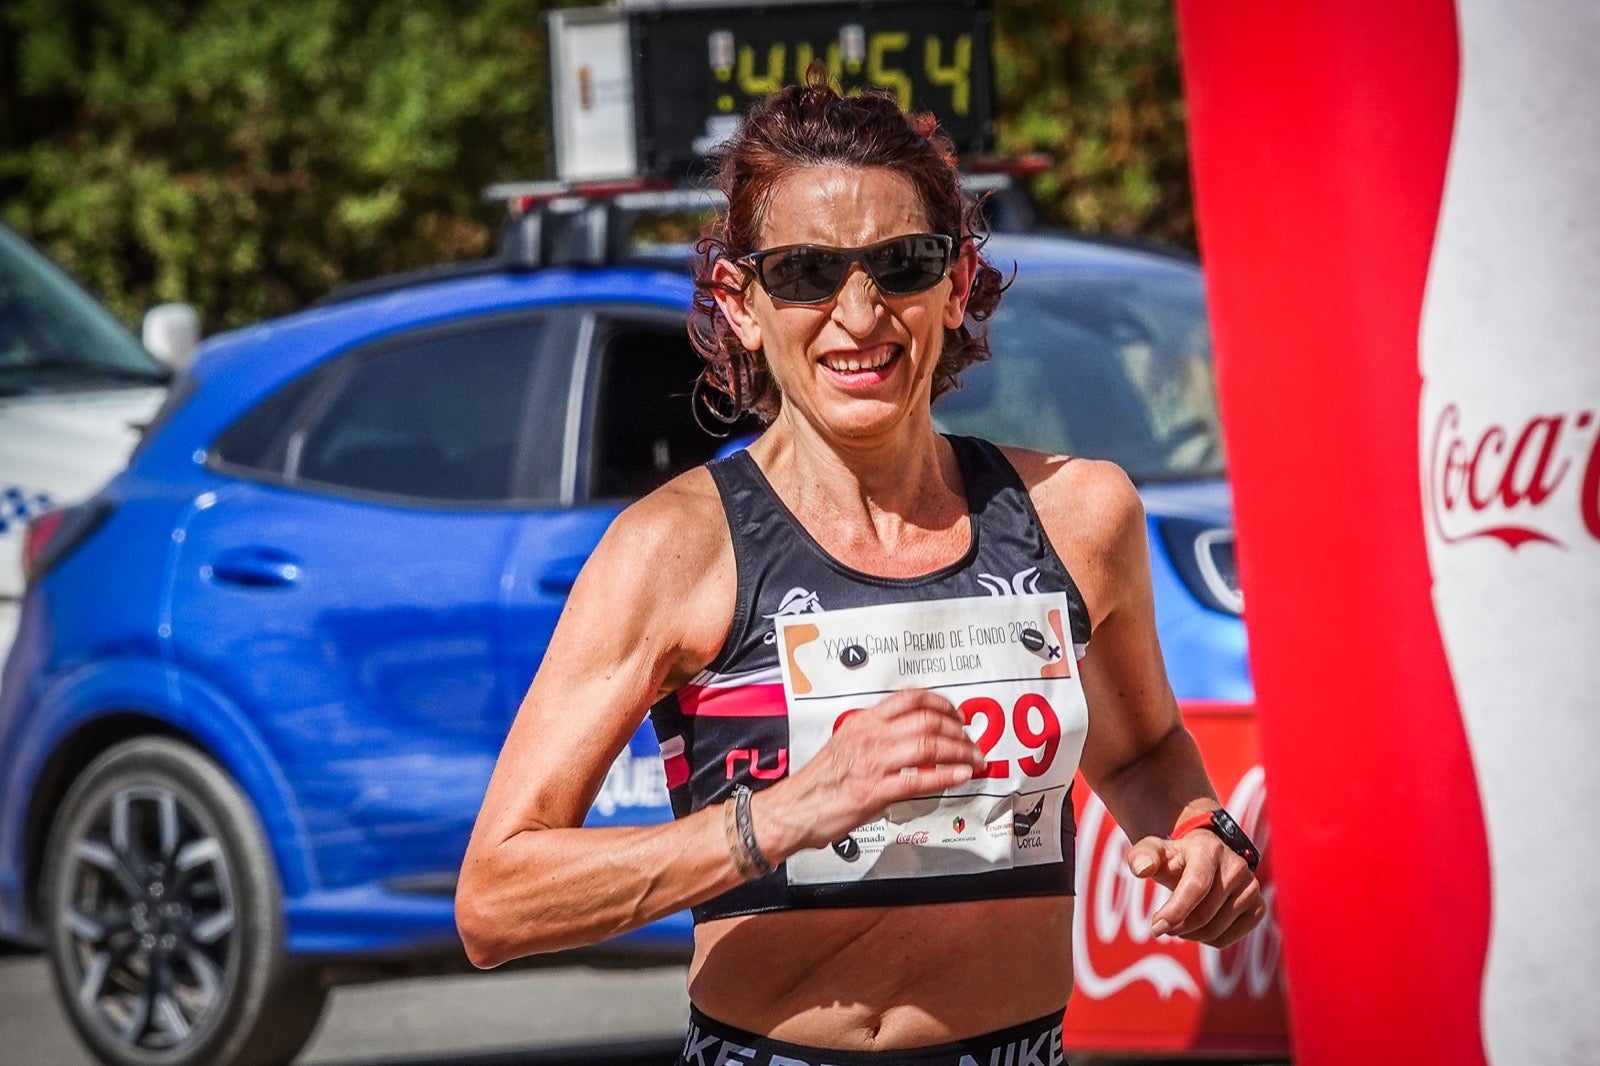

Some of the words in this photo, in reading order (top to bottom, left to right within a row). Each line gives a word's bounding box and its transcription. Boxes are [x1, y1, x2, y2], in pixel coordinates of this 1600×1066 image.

[1431, 403, 1600, 553] Coca-
[865, 634, 899, 656] GRAN
[903, 630, 945, 652] PREMIO
[950, 629, 965, 648] DE
[968, 624, 1006, 647] FONDO
[898, 656, 946, 676] UNIVERSO
[949, 653, 982, 672] LORCA
[852, 833, 886, 843] ranada
